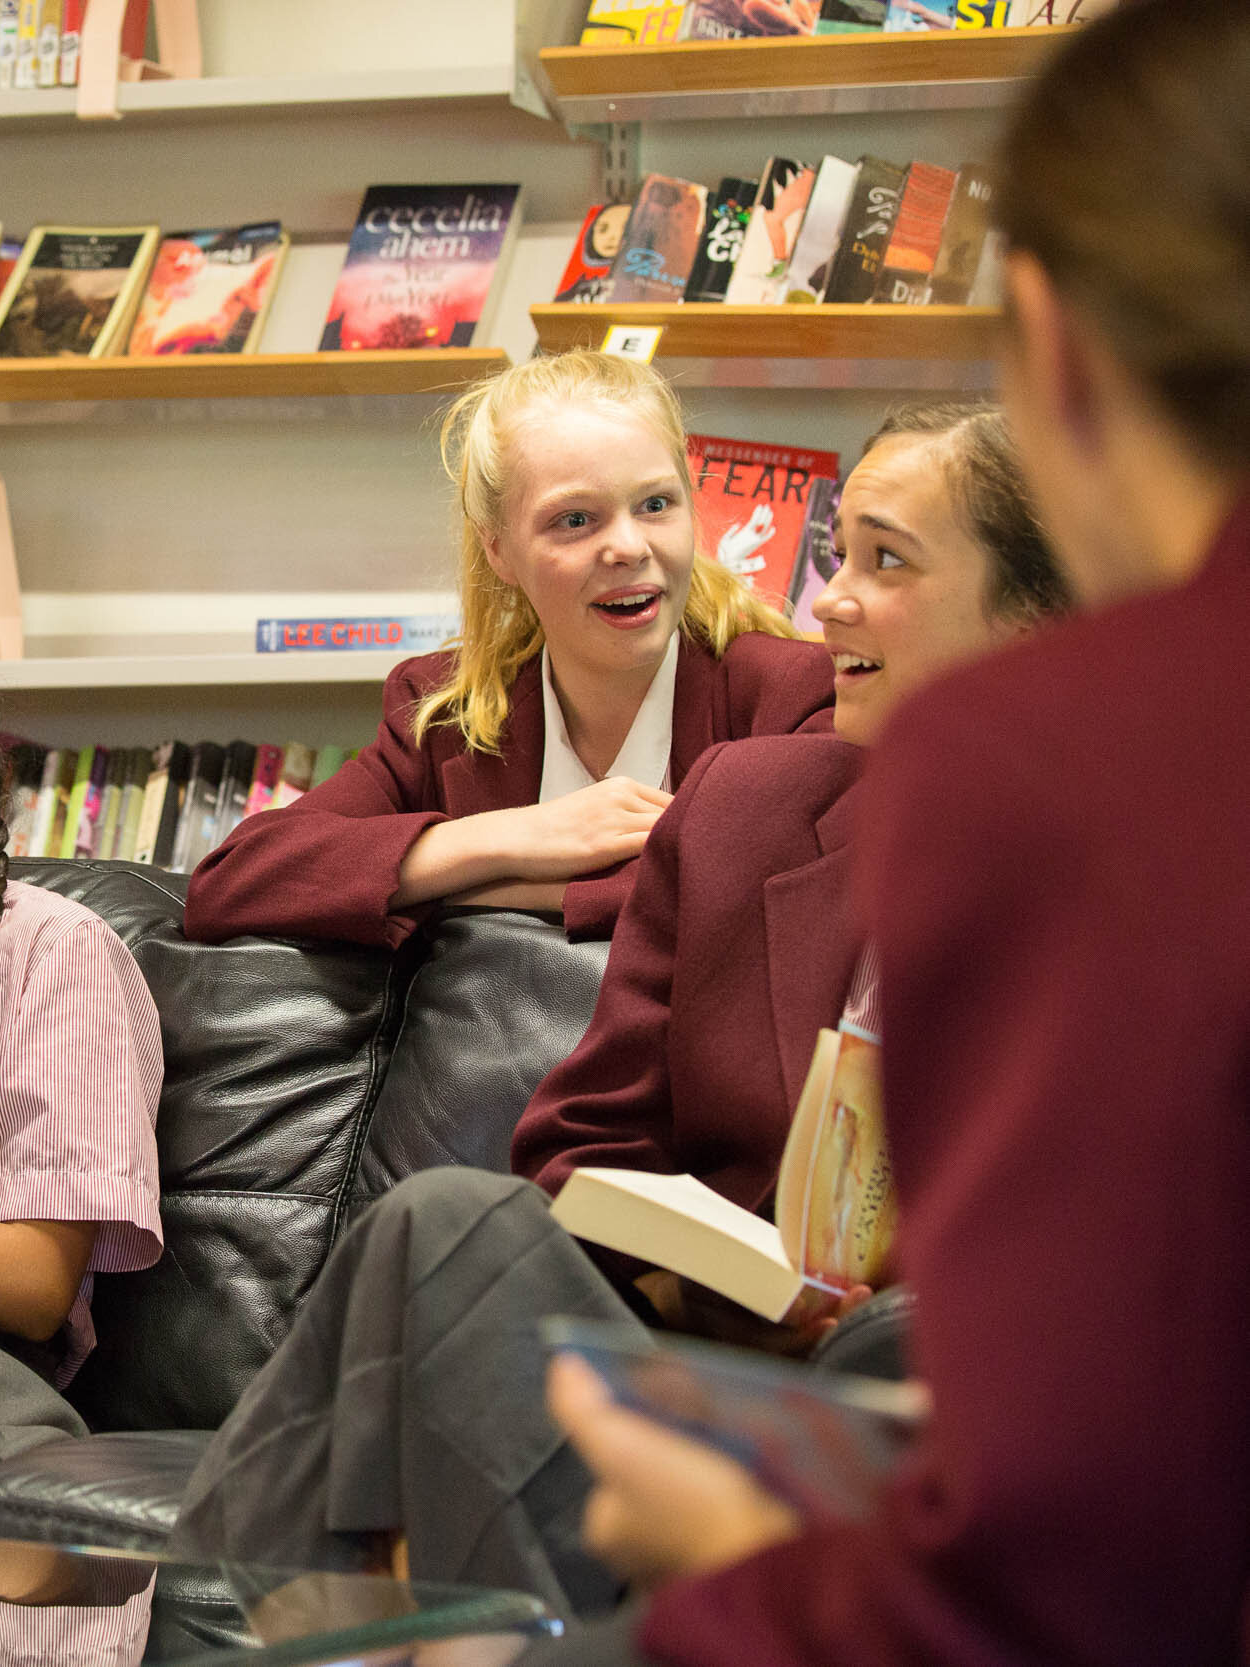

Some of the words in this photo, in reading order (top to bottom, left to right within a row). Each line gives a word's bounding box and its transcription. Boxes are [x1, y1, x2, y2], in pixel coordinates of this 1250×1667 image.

[365, 194, 502, 234] cecelia
[621, 337, 640, 352] E
[697, 455, 810, 504] FEAR
[283, 624, 327, 647] LEE
[330, 622, 404, 645] CHILD
